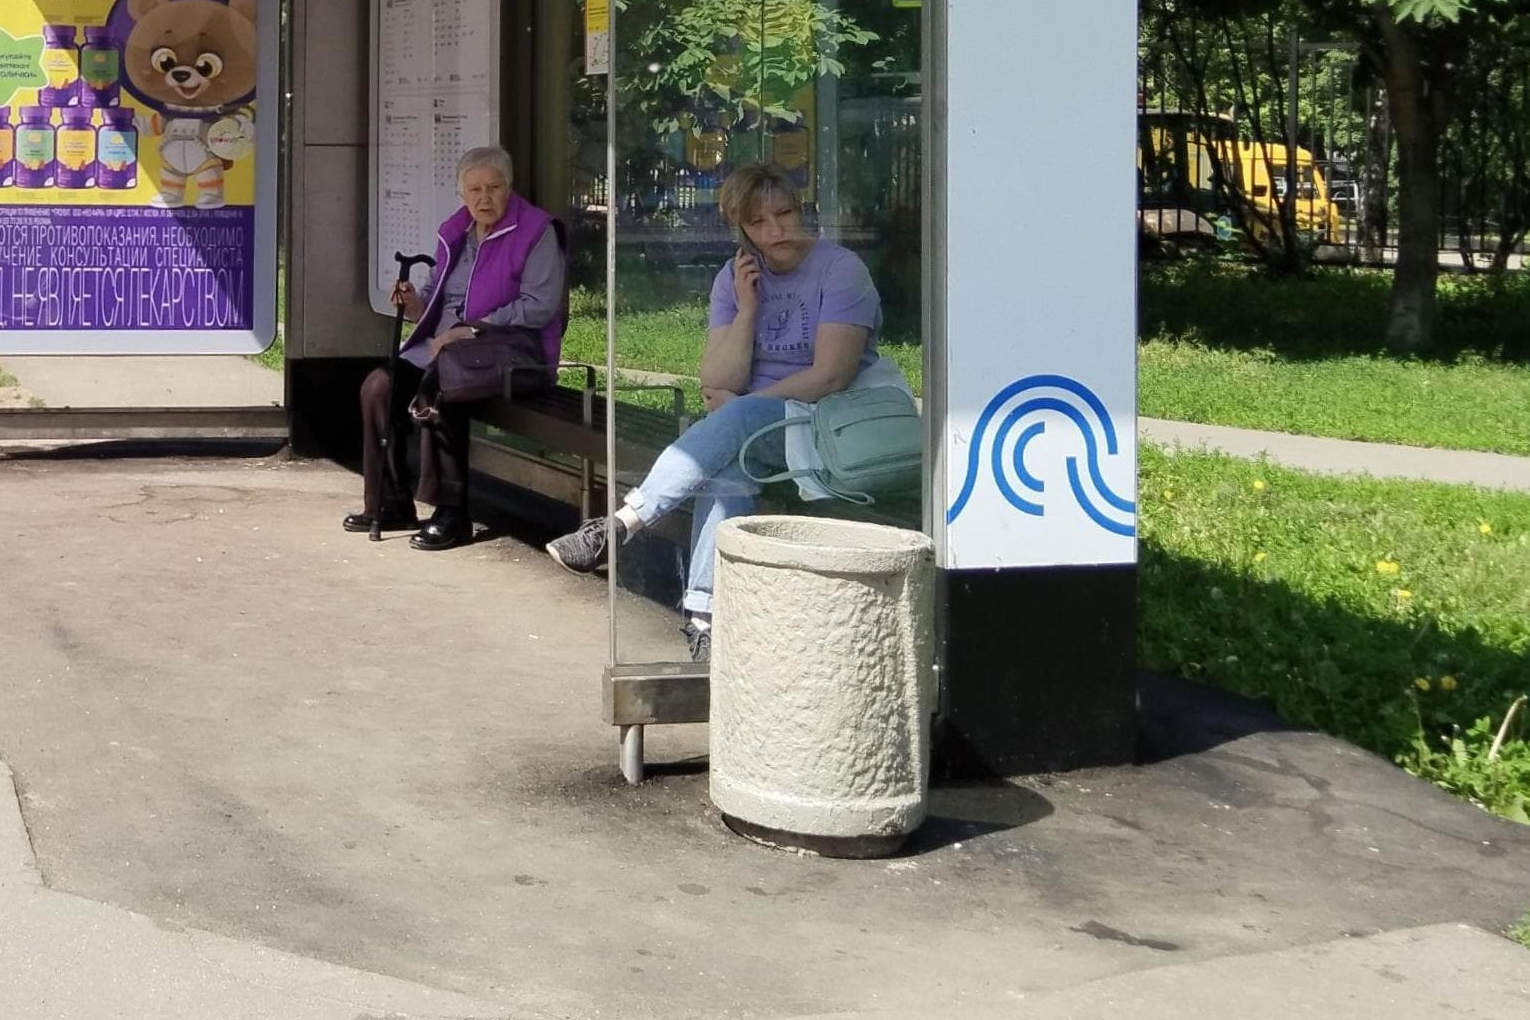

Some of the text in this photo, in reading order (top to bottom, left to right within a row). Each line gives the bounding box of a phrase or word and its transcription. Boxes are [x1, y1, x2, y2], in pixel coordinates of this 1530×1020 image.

[31, 225, 160, 246] ПРОТИВОПОКАЗАНИЯ.
[162, 226, 244, 248] НЕОБХОДИМО
[50, 245, 148, 269] КОНСУЛЬТАЦИИ
[155, 247, 244, 268] СПЕЦИАЛИСТА
[12, 268, 35, 326] НЕ
[37, 267, 125, 326] ЯВЛЯЕТСЯ
